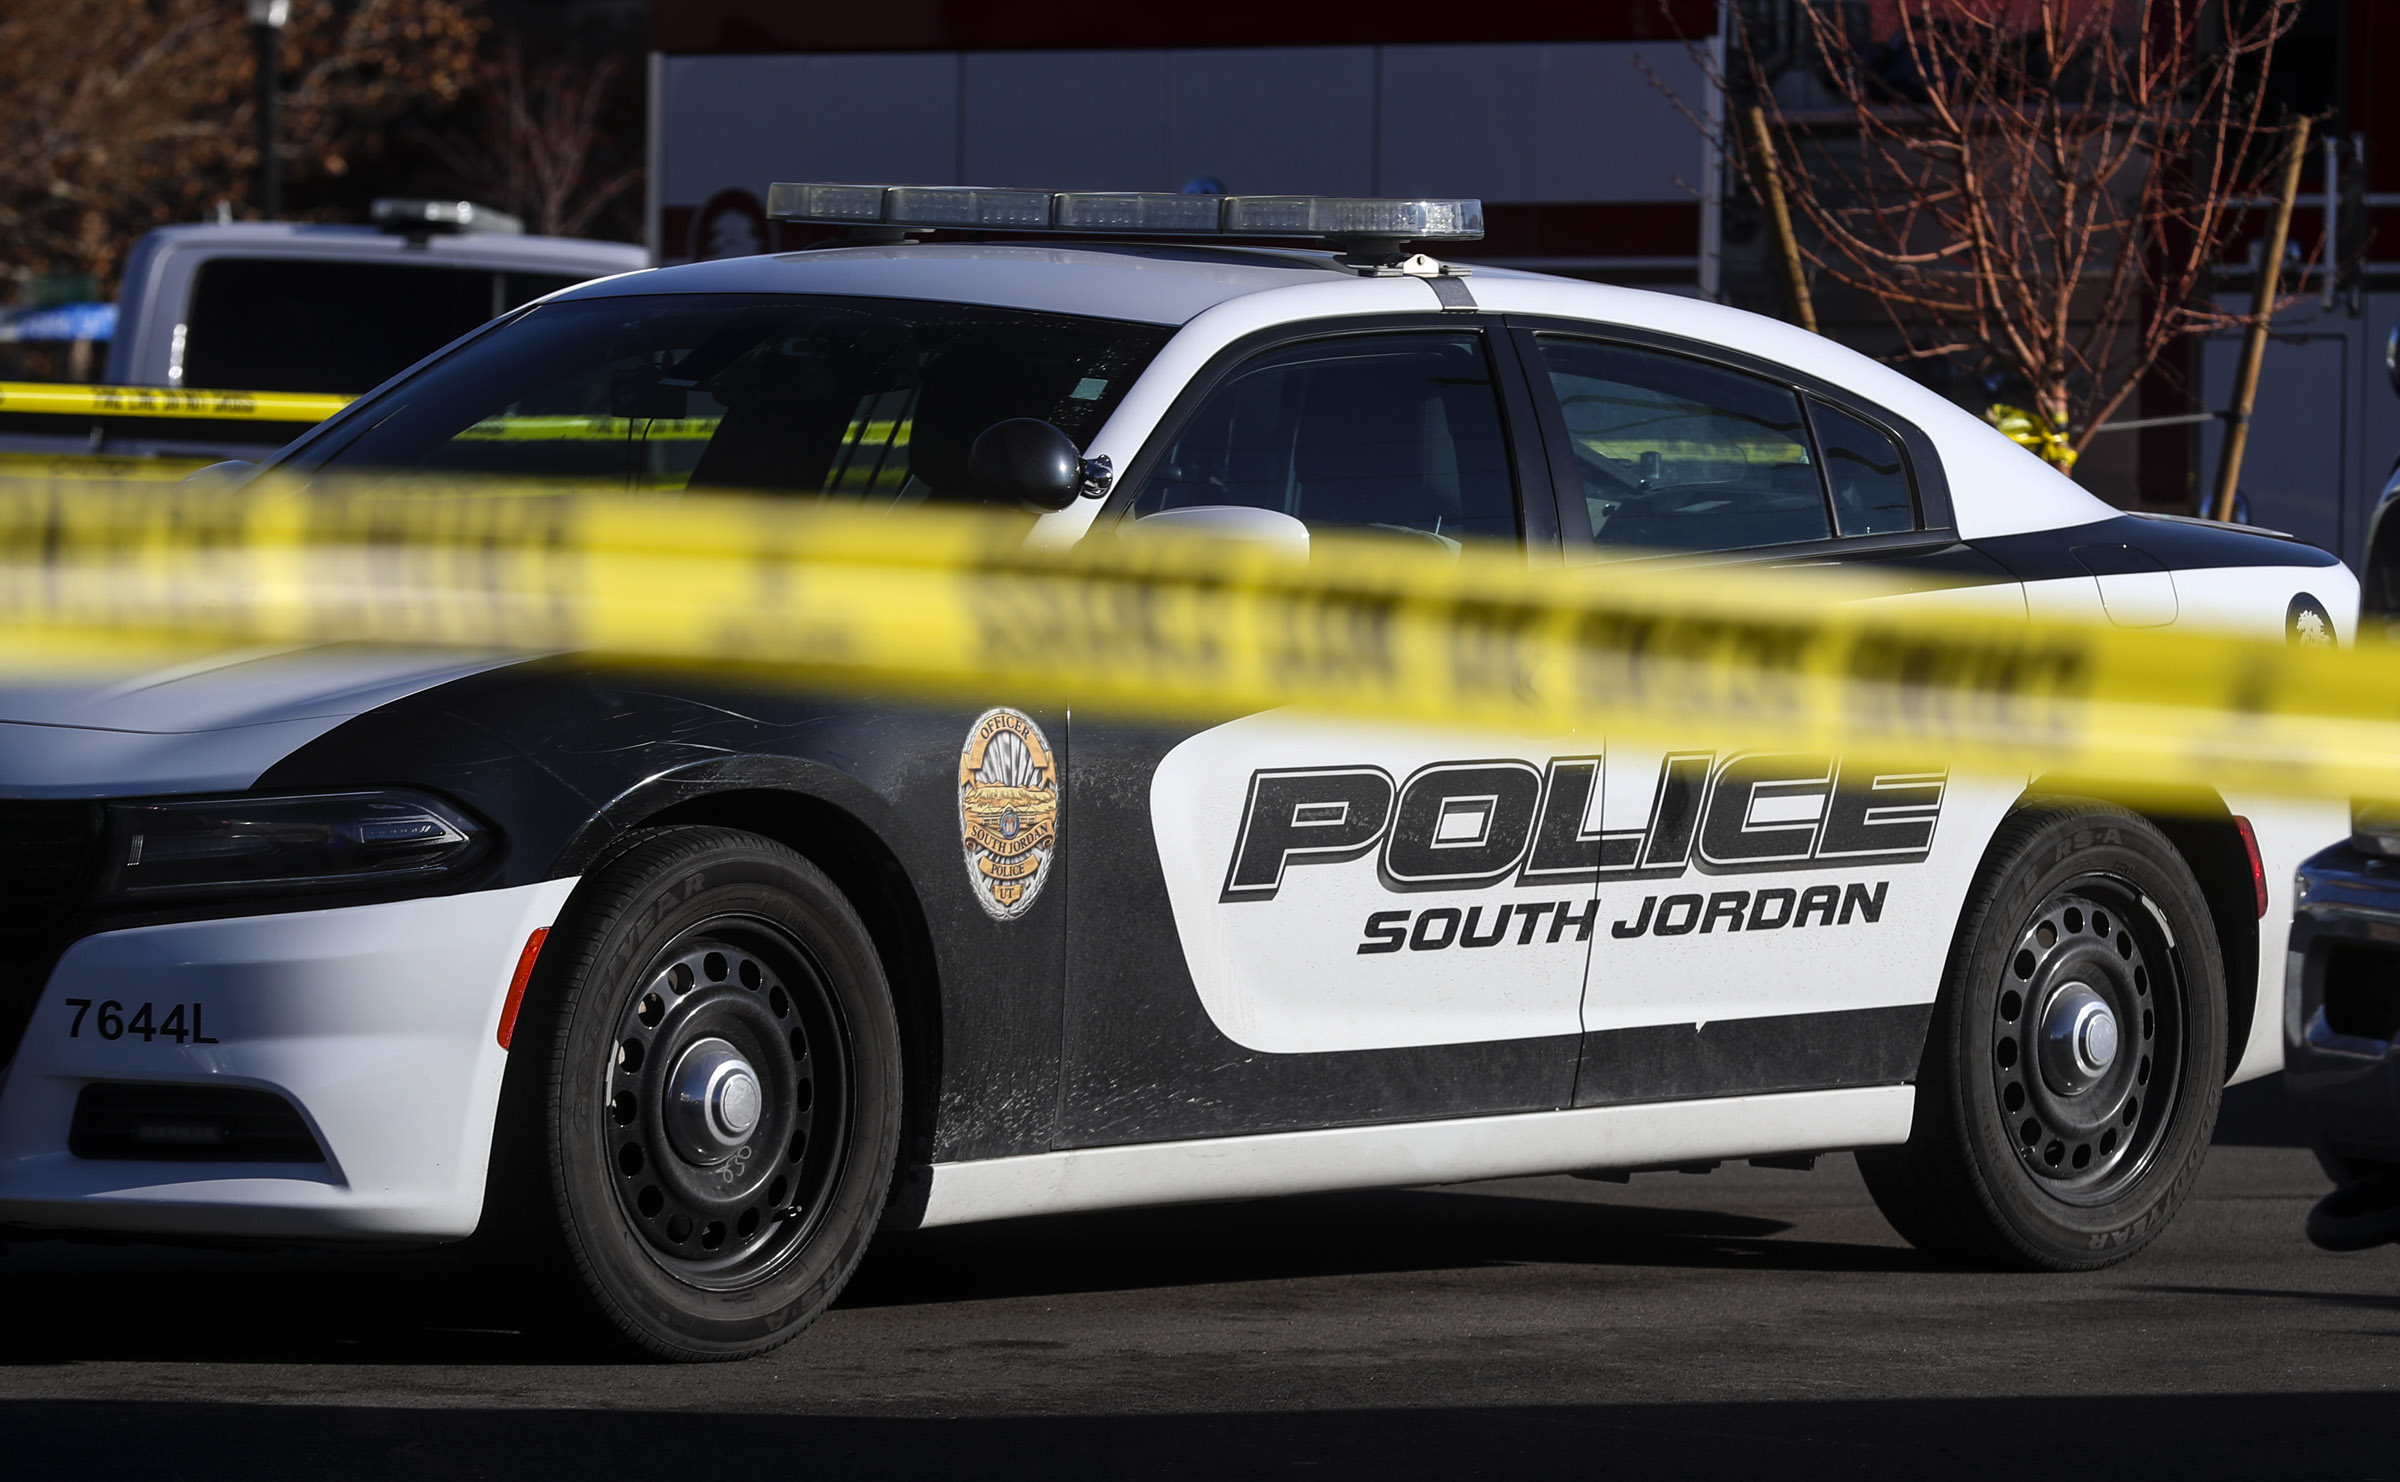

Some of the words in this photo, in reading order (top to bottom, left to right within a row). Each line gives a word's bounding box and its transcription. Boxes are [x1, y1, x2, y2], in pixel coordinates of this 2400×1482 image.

[980, 715, 1030, 741] OFFICER
[971, 824, 1006, 854] SOUTH
[1008, 822, 1048, 855] JORDAN
[1218, 748, 1951, 904] POLICE
[990, 863, 1026, 877] POLICE
[1000, 887, 1014, 900] UT
[1357, 898, 1601, 955] SOUTH
[1611, 882, 1889, 940] JORDAN
[65, 998, 220, 1044] 7644L
